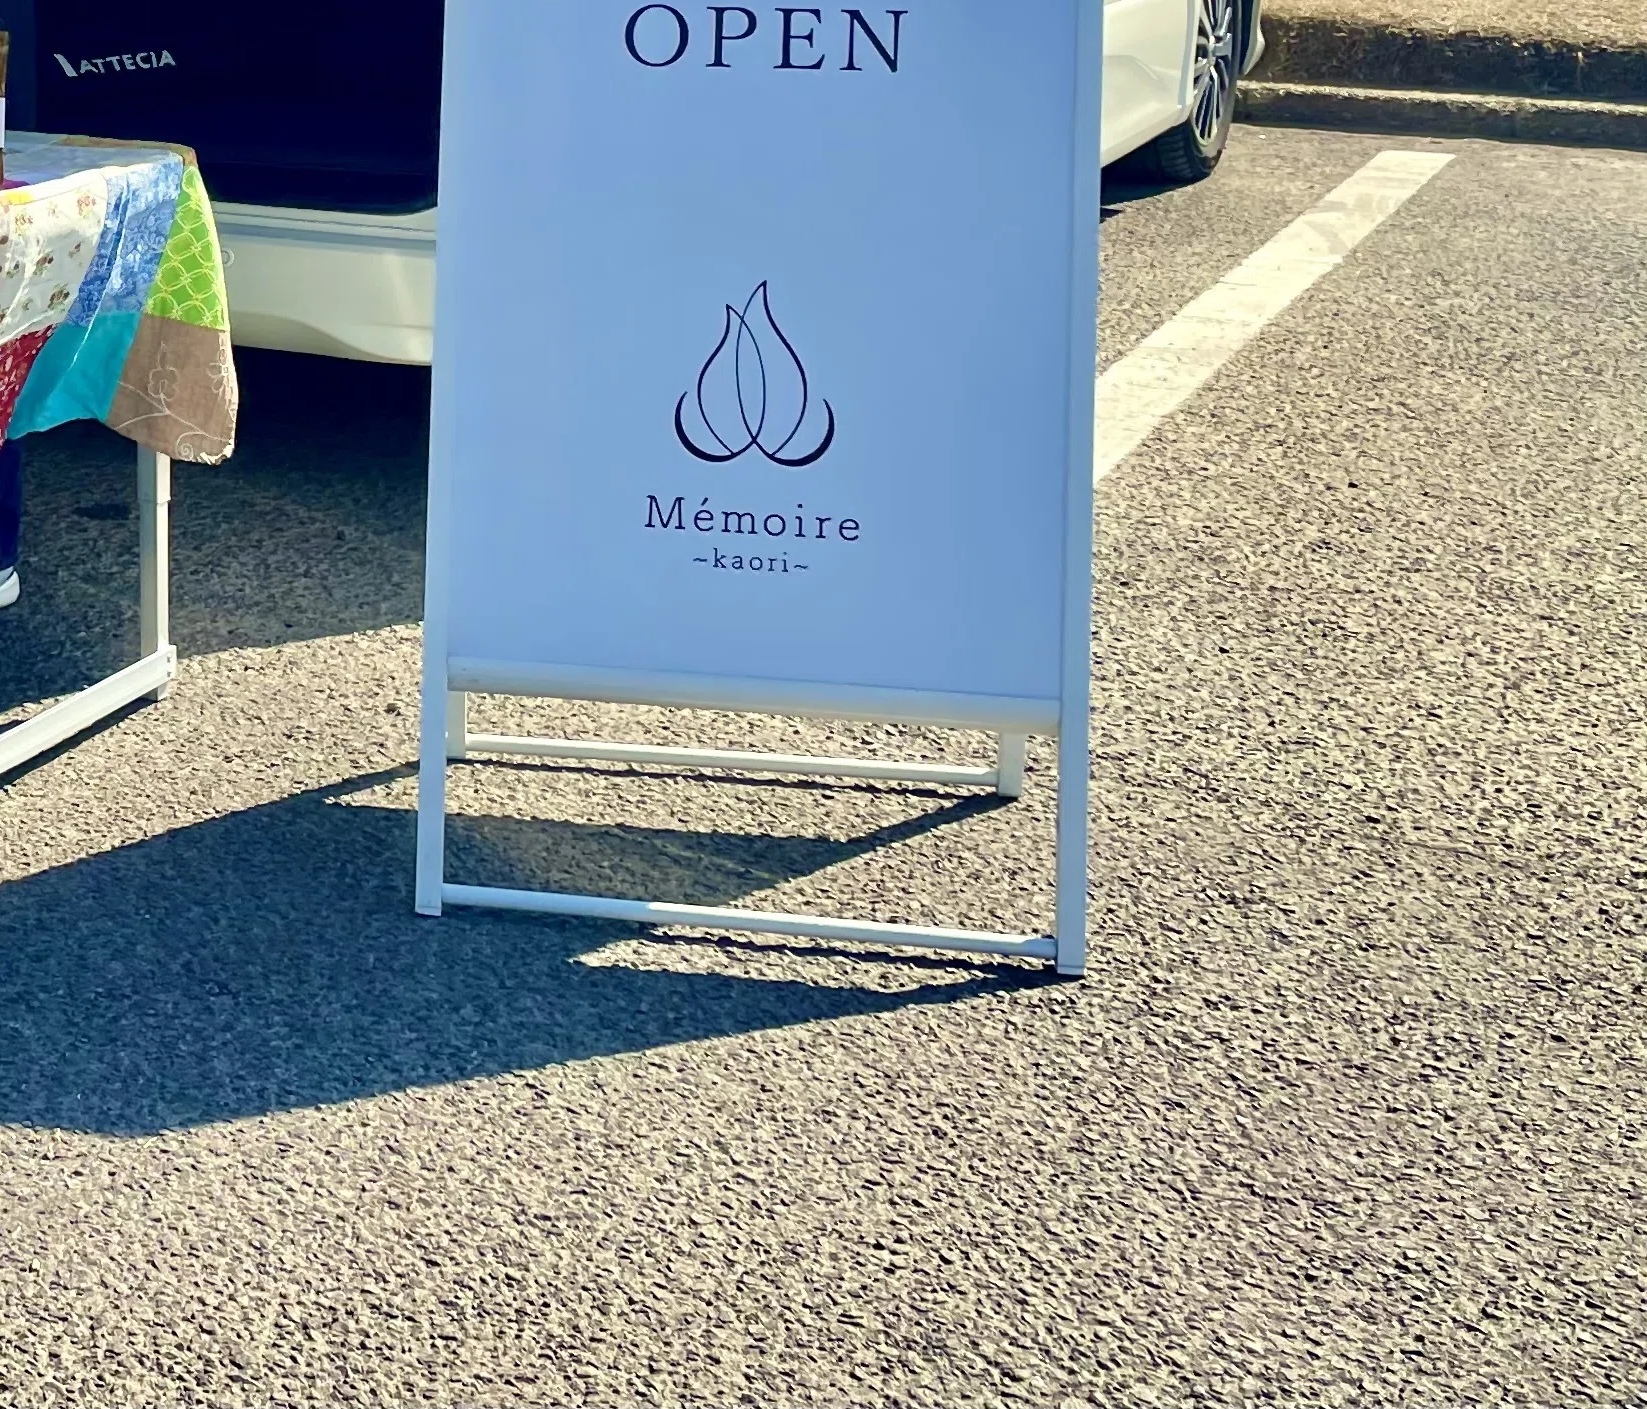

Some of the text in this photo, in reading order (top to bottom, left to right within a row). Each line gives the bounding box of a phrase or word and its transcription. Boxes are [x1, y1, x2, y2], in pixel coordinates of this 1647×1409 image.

[79, 49, 177, 74] ATTECIA
[624, 3, 909, 73] OPEN
[644, 494, 861, 541] Mémoire
